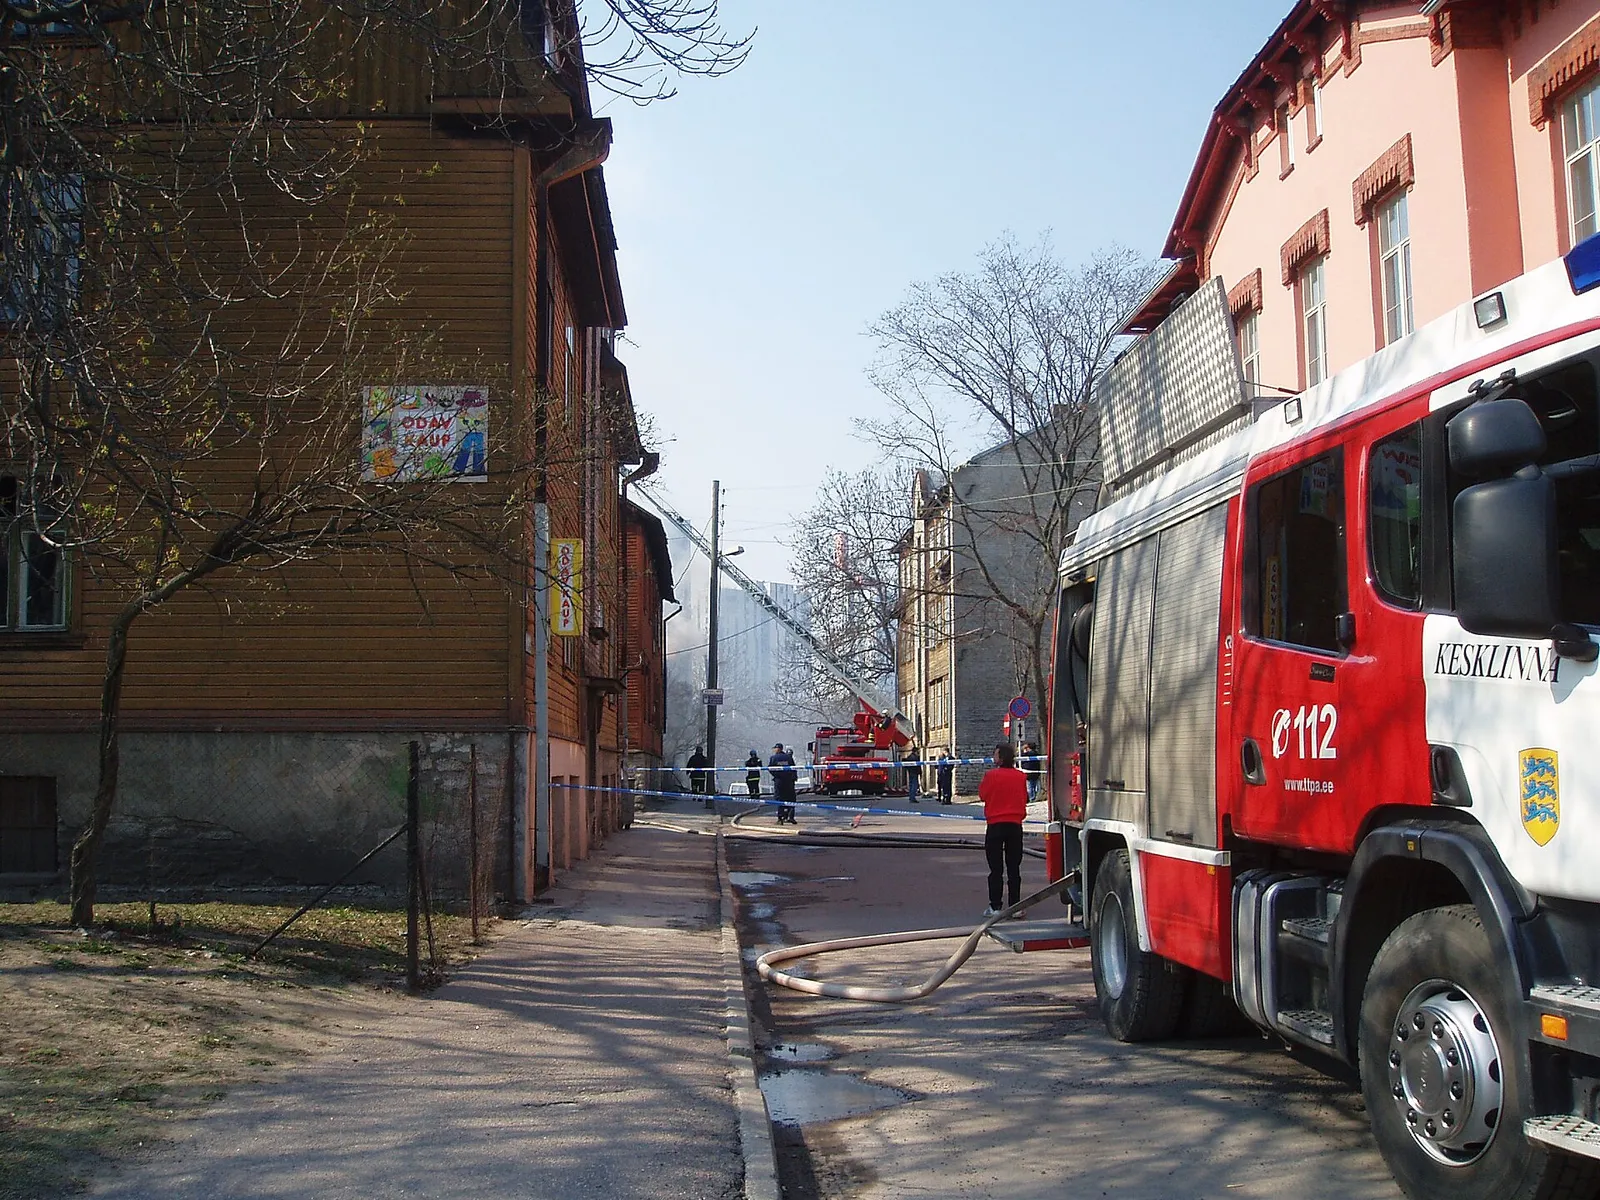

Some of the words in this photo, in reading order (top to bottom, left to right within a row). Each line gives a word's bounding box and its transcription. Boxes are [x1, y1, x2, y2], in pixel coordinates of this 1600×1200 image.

[402, 415, 453, 429] ODAV
[1434, 643, 1561, 683] KESKLINNA
[1293, 703, 1337, 759] 112
[1284, 777, 1334, 796] www.ttpa.ee
